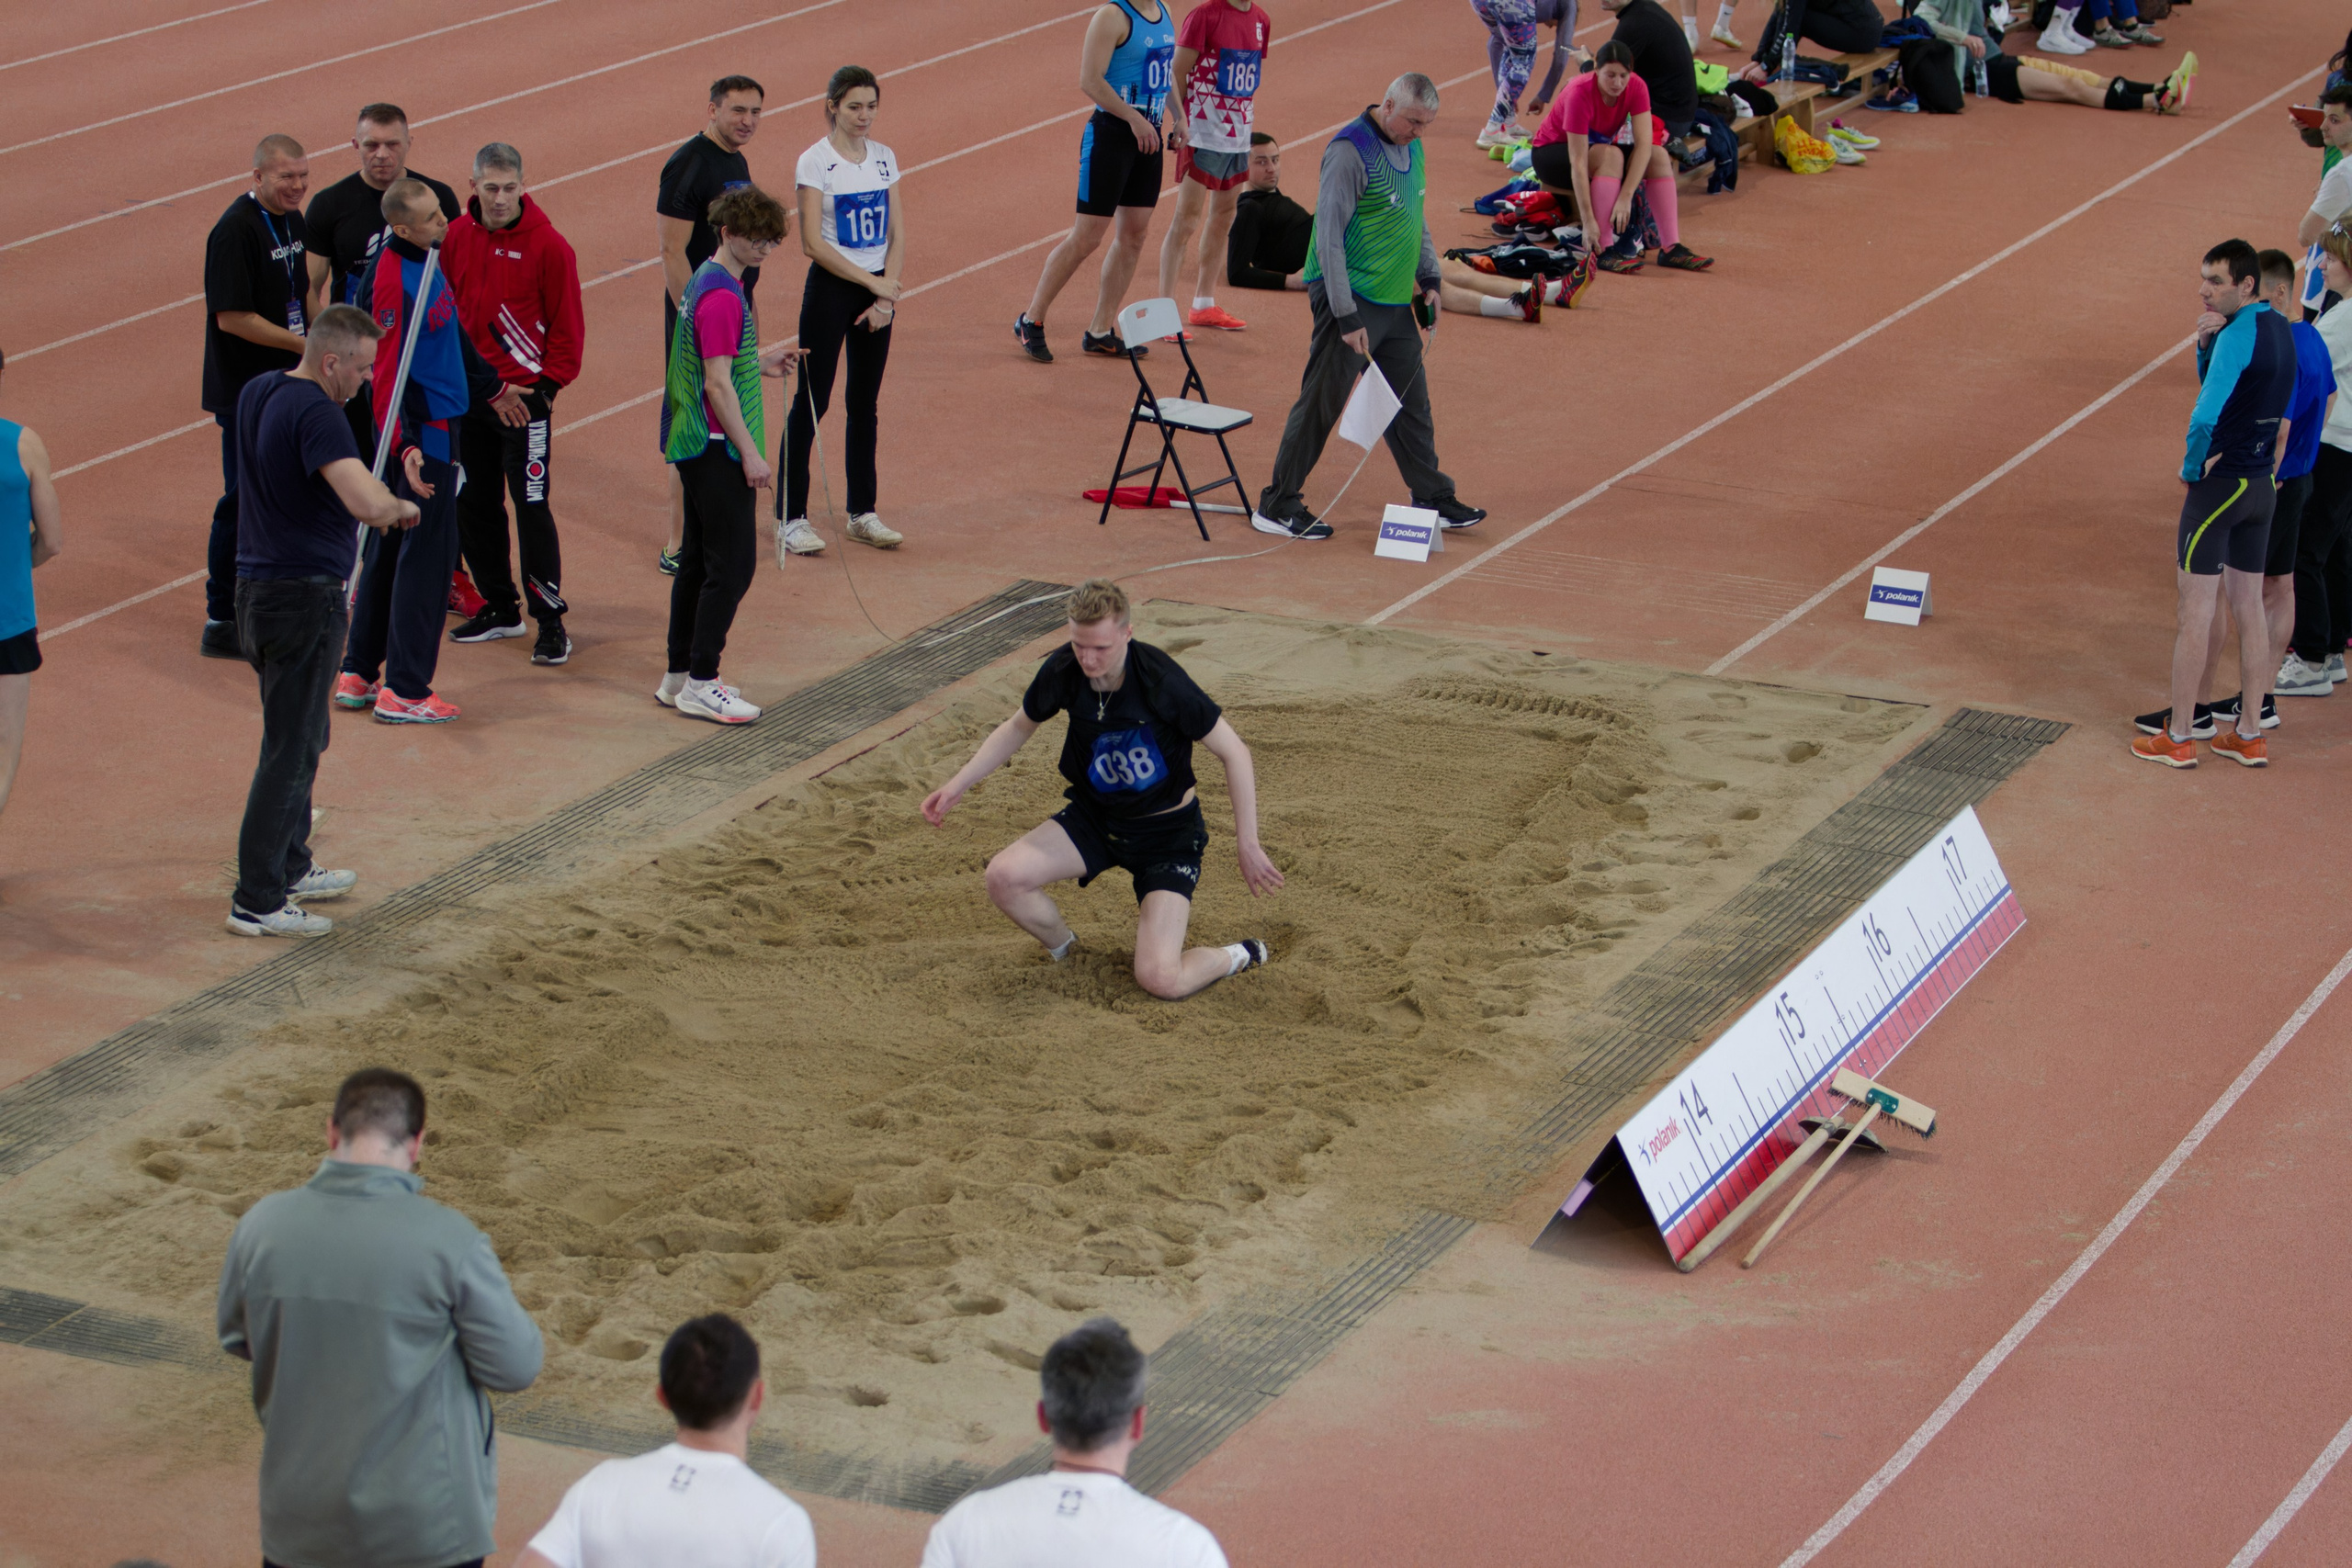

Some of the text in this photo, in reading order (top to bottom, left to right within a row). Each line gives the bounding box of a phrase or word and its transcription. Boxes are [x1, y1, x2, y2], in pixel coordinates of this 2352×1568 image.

[1227, 62, 1256, 92] 186
[846, 206, 885, 243] 167
[1395, 528, 1428, 539] polanik
[1884, 592, 1919, 603] polanik
[1094, 747, 1156, 785] 038
[1941, 835, 1967, 886] 17
[1861, 912, 1892, 963] 16
[1775, 991, 1806, 1046] 15
[1679, 1078, 1713, 1136] 14
[1648, 1114, 1681, 1164] polanik
